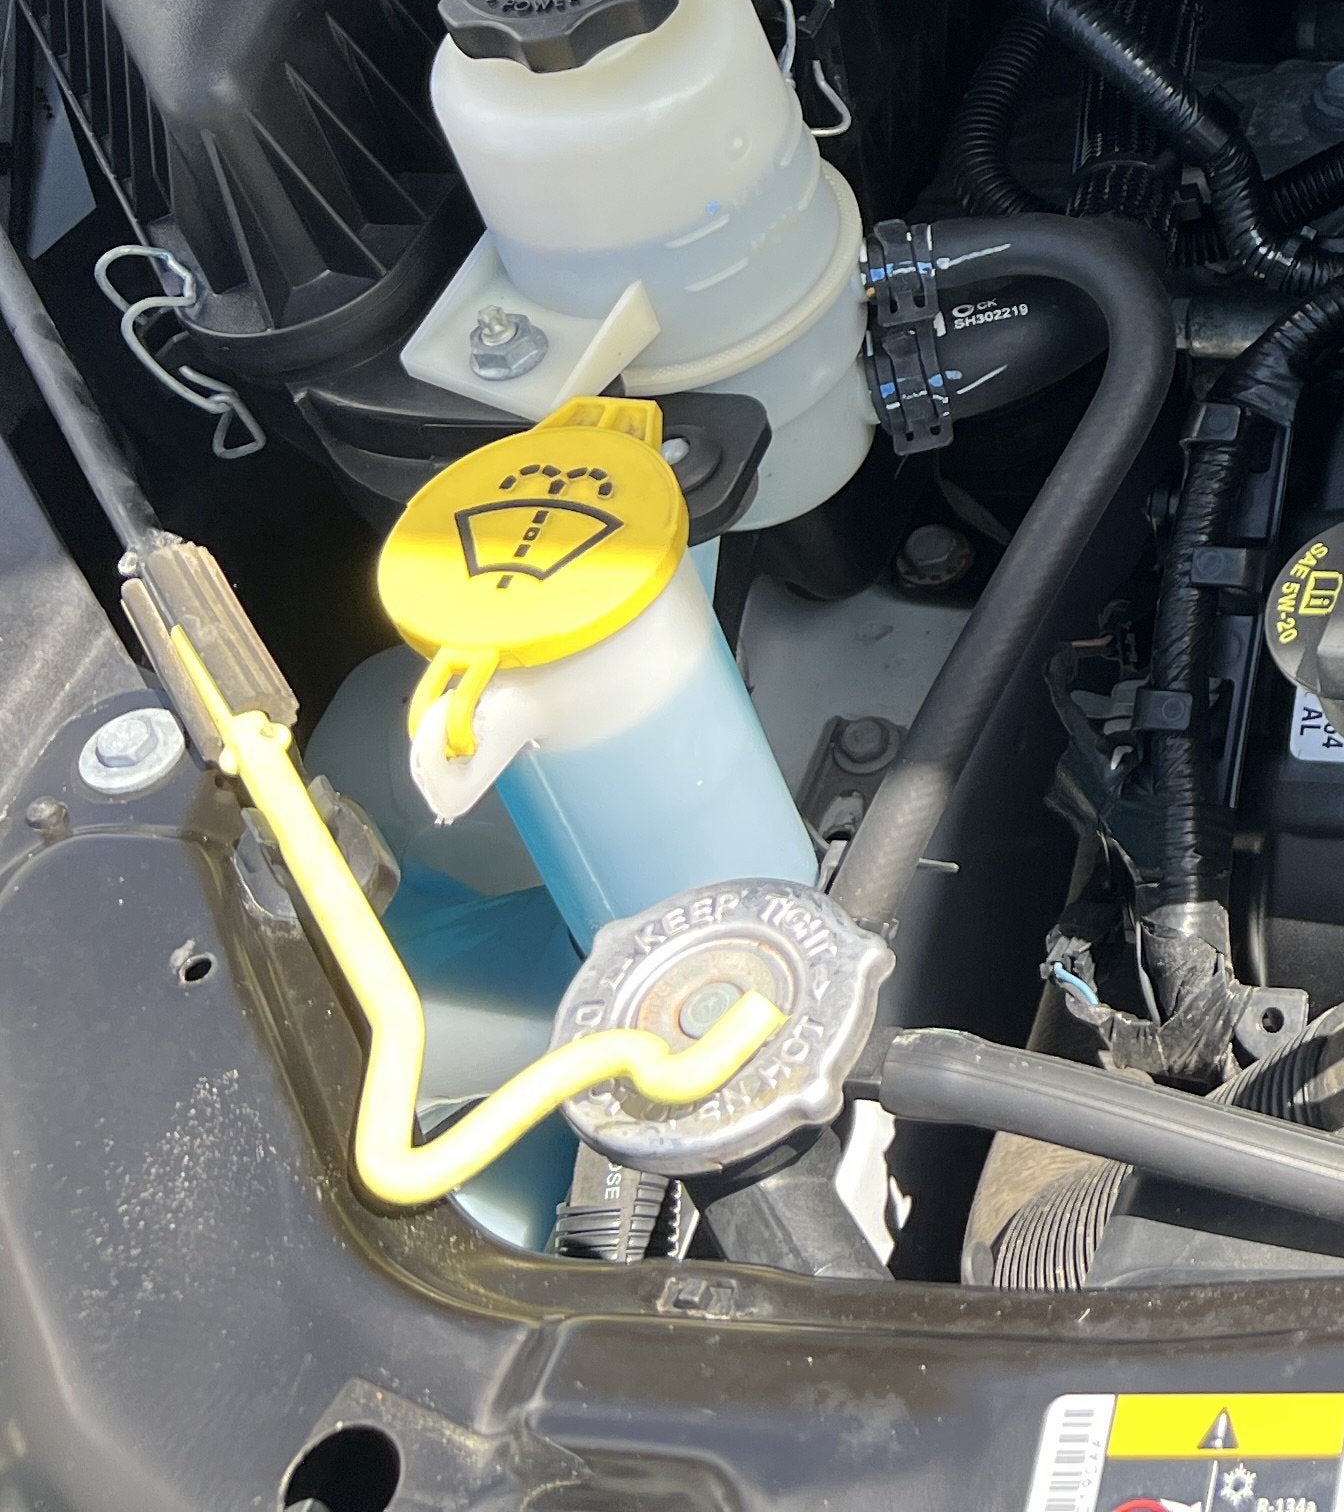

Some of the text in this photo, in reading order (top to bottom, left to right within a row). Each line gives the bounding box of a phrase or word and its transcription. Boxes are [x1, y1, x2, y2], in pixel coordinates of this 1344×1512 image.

[953, 303, 1030, 330] SH302219
[1276, 542, 1329, 644] SAE 5W-20
[1299, 707, 1323, 736] AL
[635, 892, 737, 953] KEEP
